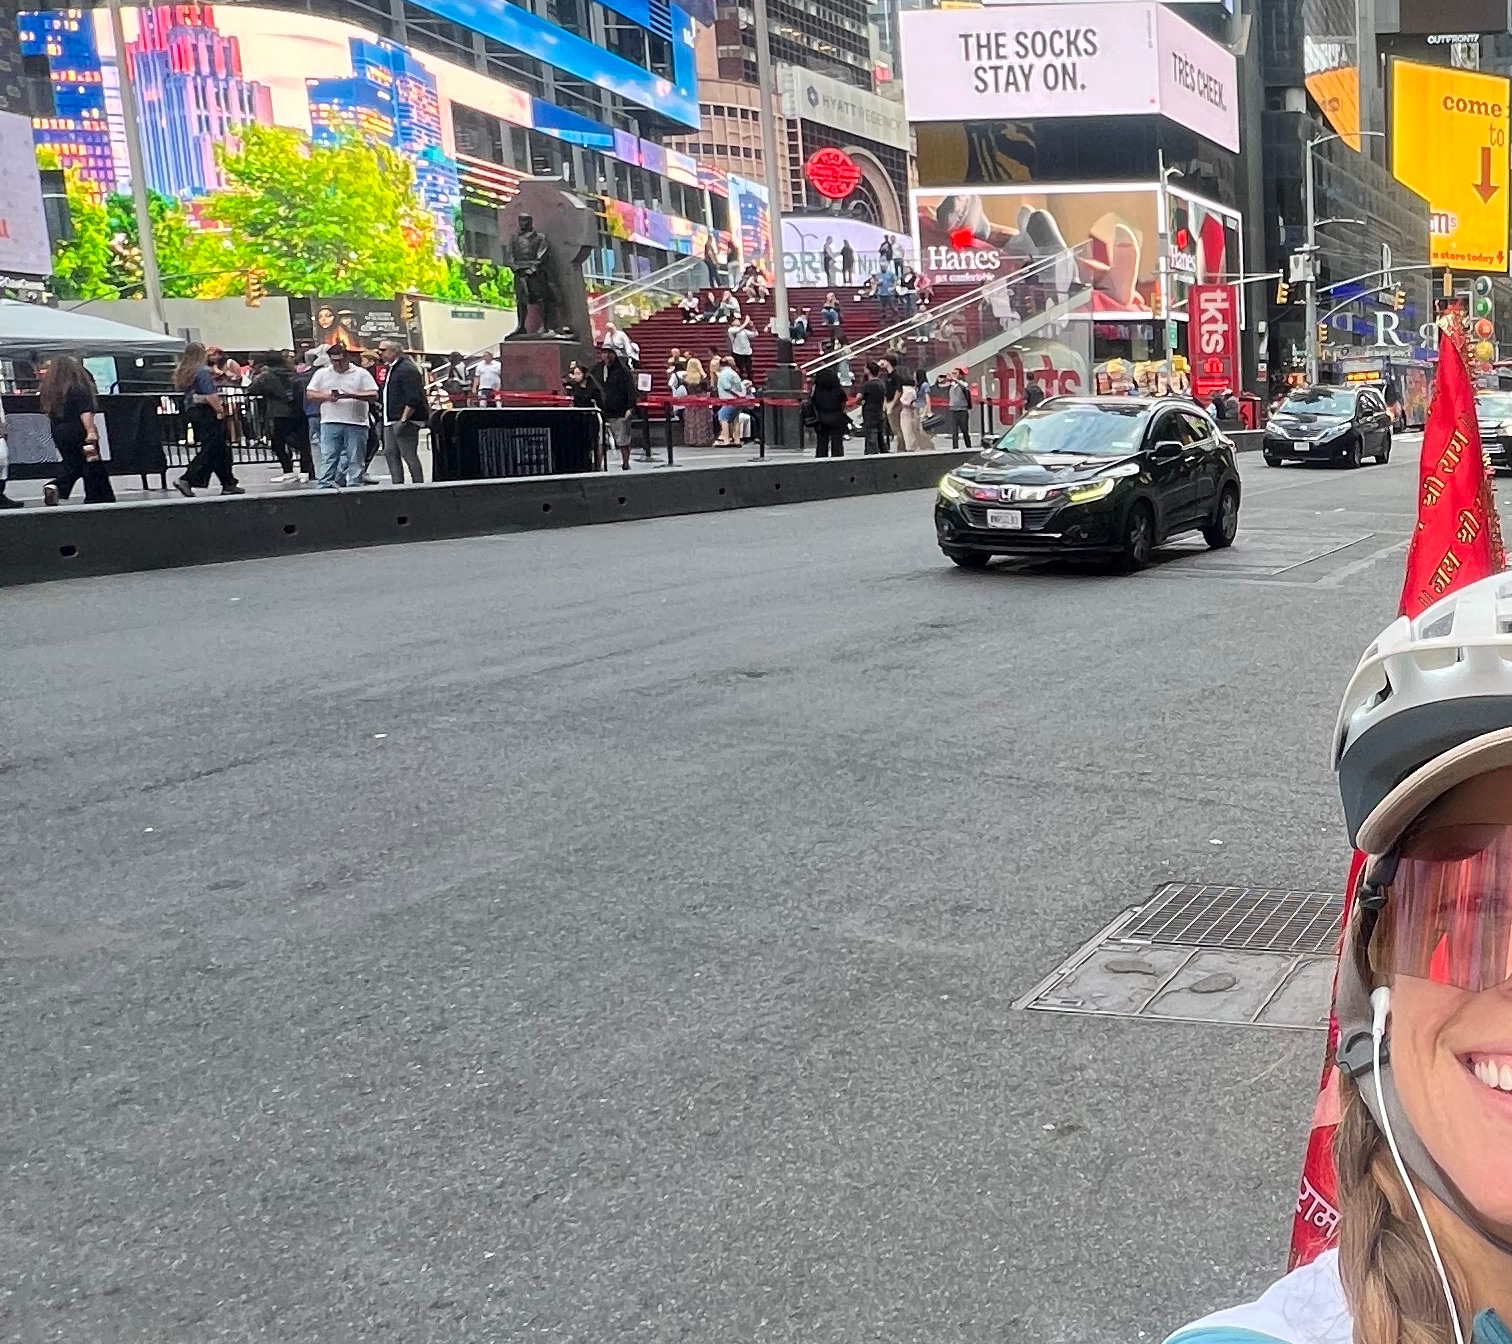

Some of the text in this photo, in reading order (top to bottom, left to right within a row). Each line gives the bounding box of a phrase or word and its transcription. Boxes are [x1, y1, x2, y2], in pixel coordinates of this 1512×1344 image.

[958, 28, 1098, 61] THE SOCKS
[974, 62, 1087, 93] STAY ON.
[822, 94, 857, 114] HYATT
[1442, 95, 1502, 117] come
[1488, 122, 1505, 147] to
[927, 245, 1001, 271] Hanes
[1199, 289, 1230, 354] tkts
